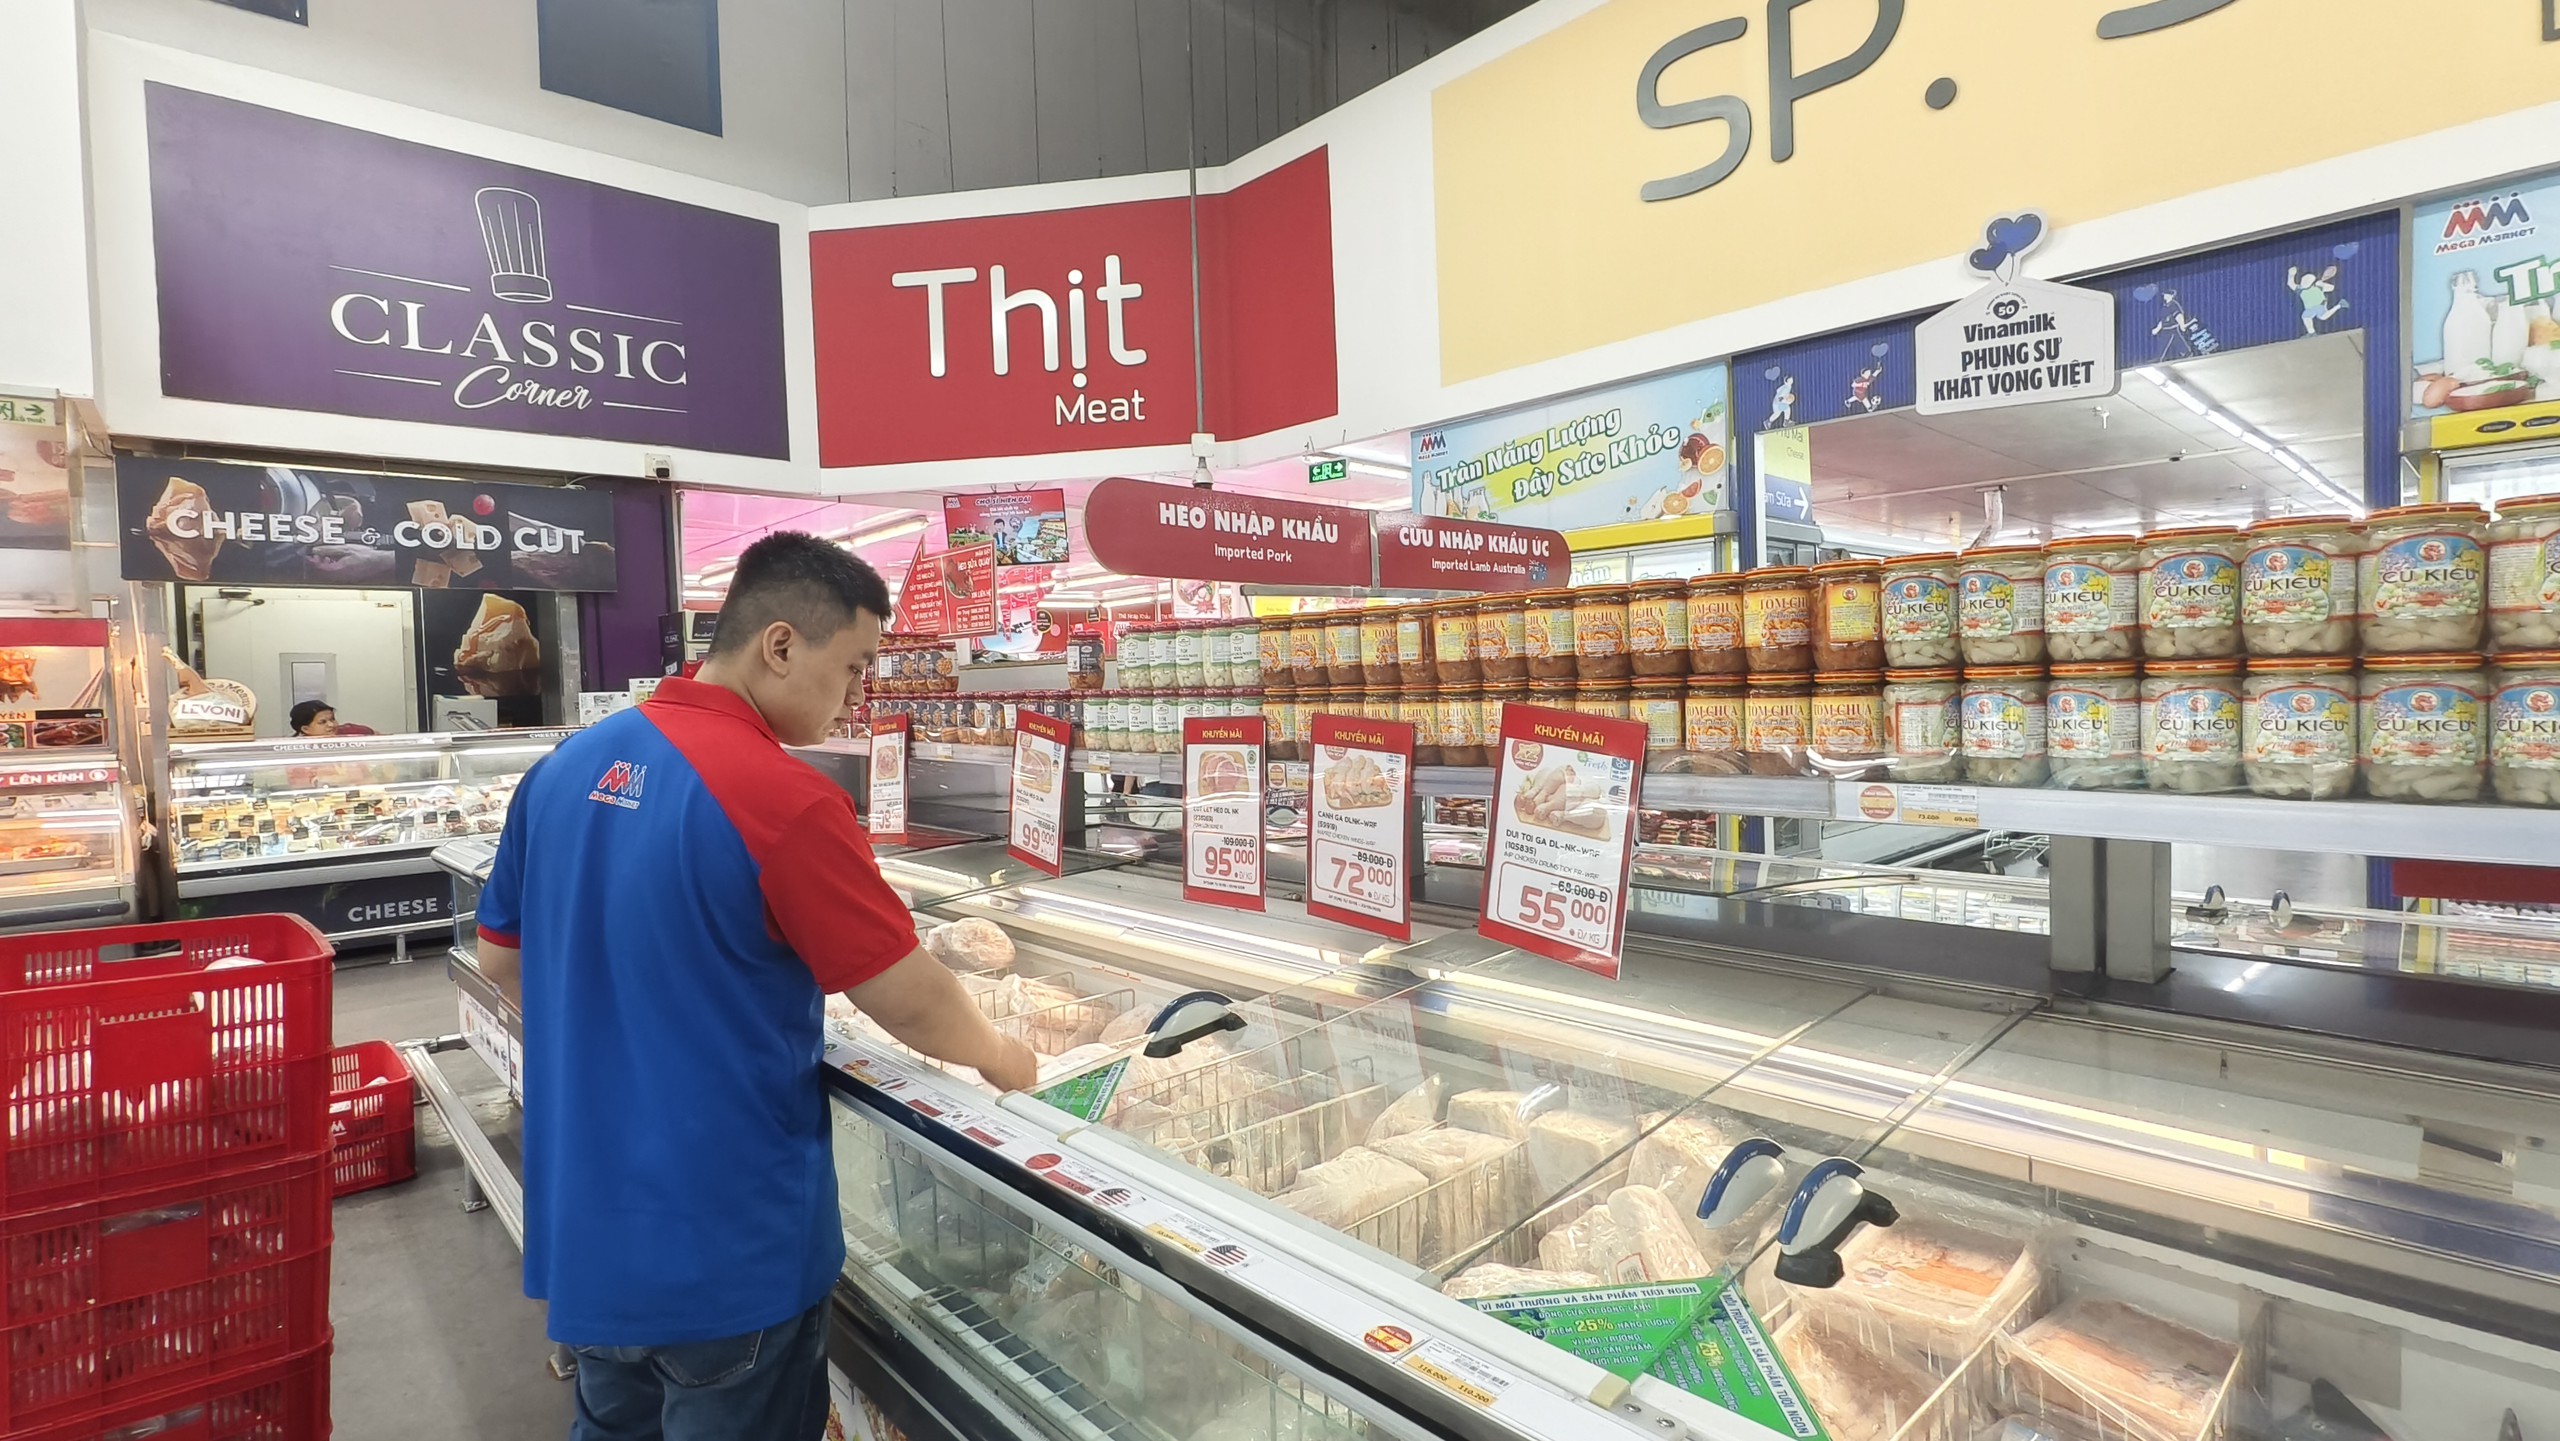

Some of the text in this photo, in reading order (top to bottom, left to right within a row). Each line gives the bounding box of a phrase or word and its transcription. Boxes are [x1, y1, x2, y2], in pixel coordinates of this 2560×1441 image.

[891, 254, 1147, 388] Thịt
[1963, 313, 2057, 343] Vinamilk
[330, 292, 688, 385] CLASSIC
[1961, 336, 2063, 373] PHỤNG SỰ
[454, 366, 591, 412] Corner
[1933, 359, 2095, 402] KHÁT VỌNG VIỆT
[1055, 390, 1146, 426] Meat
[1436, 407, 1622, 492] Tràn Năng Lượng
[1513, 424, 1681, 503] Đầy Sức Khỏe
[166, 508, 584, 555] CHEESE & COLD CUT
[1159, 502, 1339, 544] HEO NHẬP KHẨU
[1214, 543, 1292, 564] Imported Pork
[1399, 523, 1550, 557] CỪU NHẬP KHẨU ÚC
[1432, 557, 1526, 576] Imported Lamb Australia
[181, 703, 241, 719] LEVONI
[1202, 725, 1228, 739] KHUYẾN
[1334, 728, 1385, 746] KHUYẾN MÃI
[1534, 723, 1605, 747] KHUYẾN MÃI
[9, 773, 42, 785] LÊN
[47, 771, 84, 783] KÍNH
[1022, 823, 1040, 851] 99
[1535, 836, 1547, 846] GA
[1205, 846, 1255, 877] 95 000
[1330, 857, 1393, 896] 72 000
[347, 897, 438, 922] CHEESE
[1519, 885, 1606, 931] 55 000
[1574, 1317, 1614, 1333] 25%
